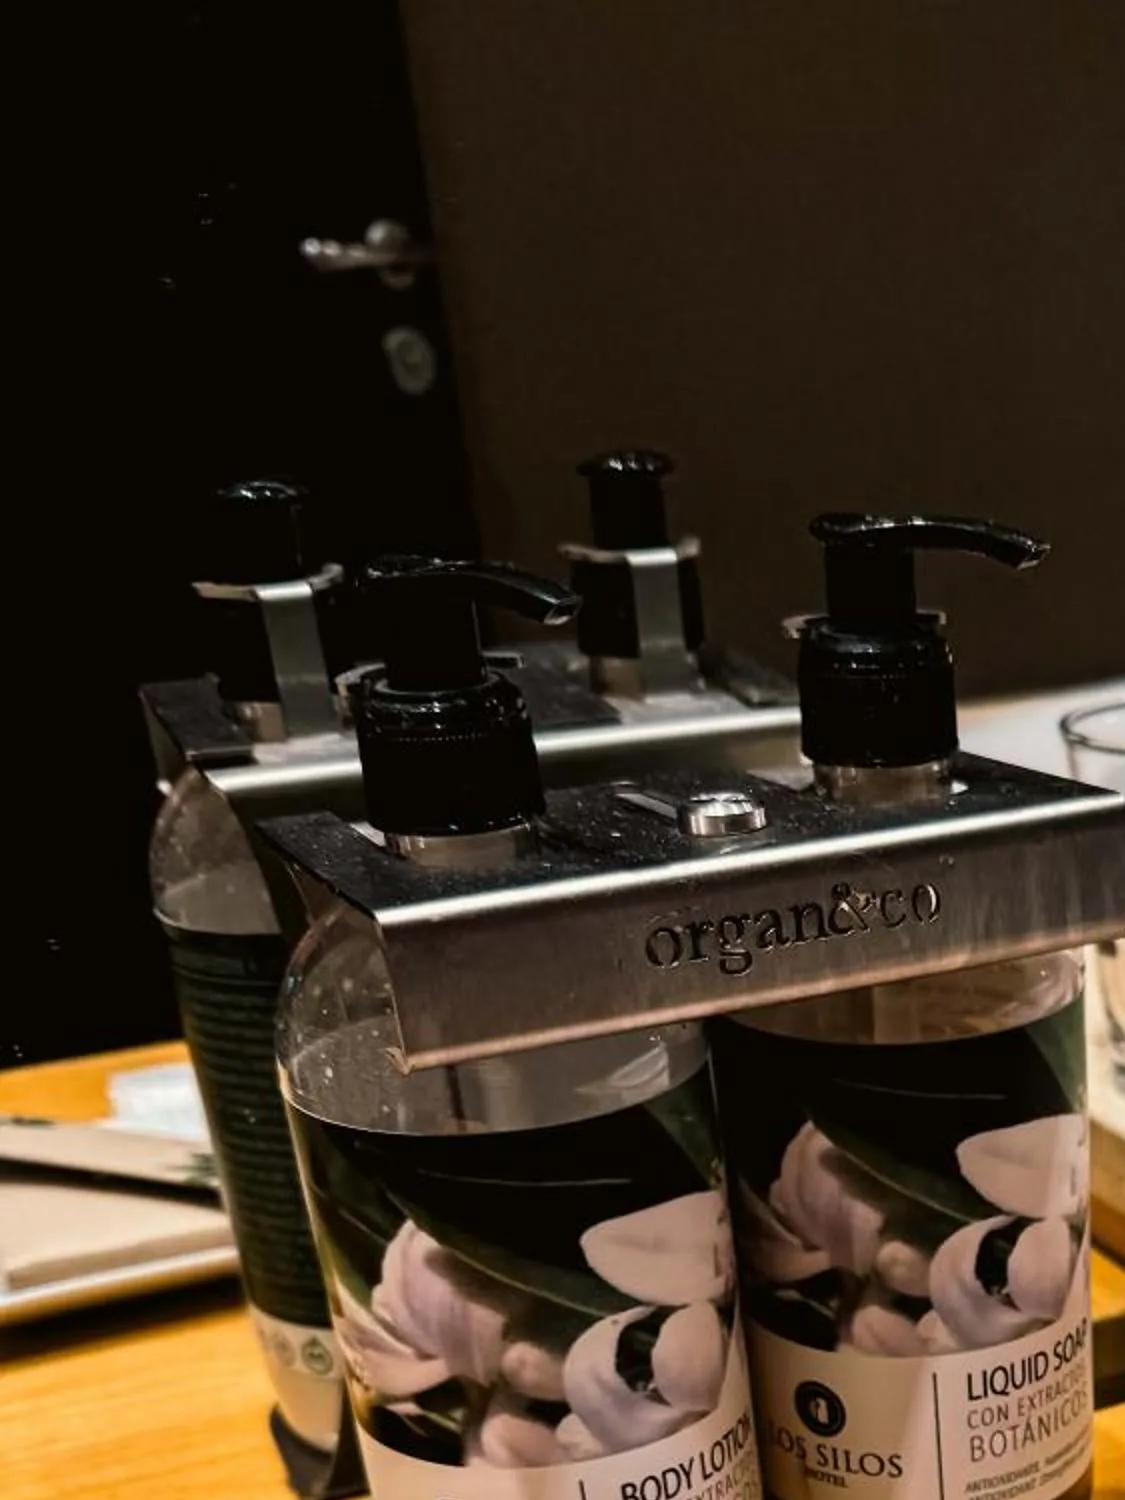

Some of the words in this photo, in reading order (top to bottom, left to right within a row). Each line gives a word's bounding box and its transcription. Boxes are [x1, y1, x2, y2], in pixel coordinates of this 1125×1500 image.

[645, 883, 942, 977] organ&co
[966, 1351, 1050, 1402] LIQUID
[967, 1404, 1010, 1430] CON
[699, 1411, 751, 1481] LOTION
[816, 1443, 904, 1478] SILOS
[804, 1466, 849, 1489] HOTEL
